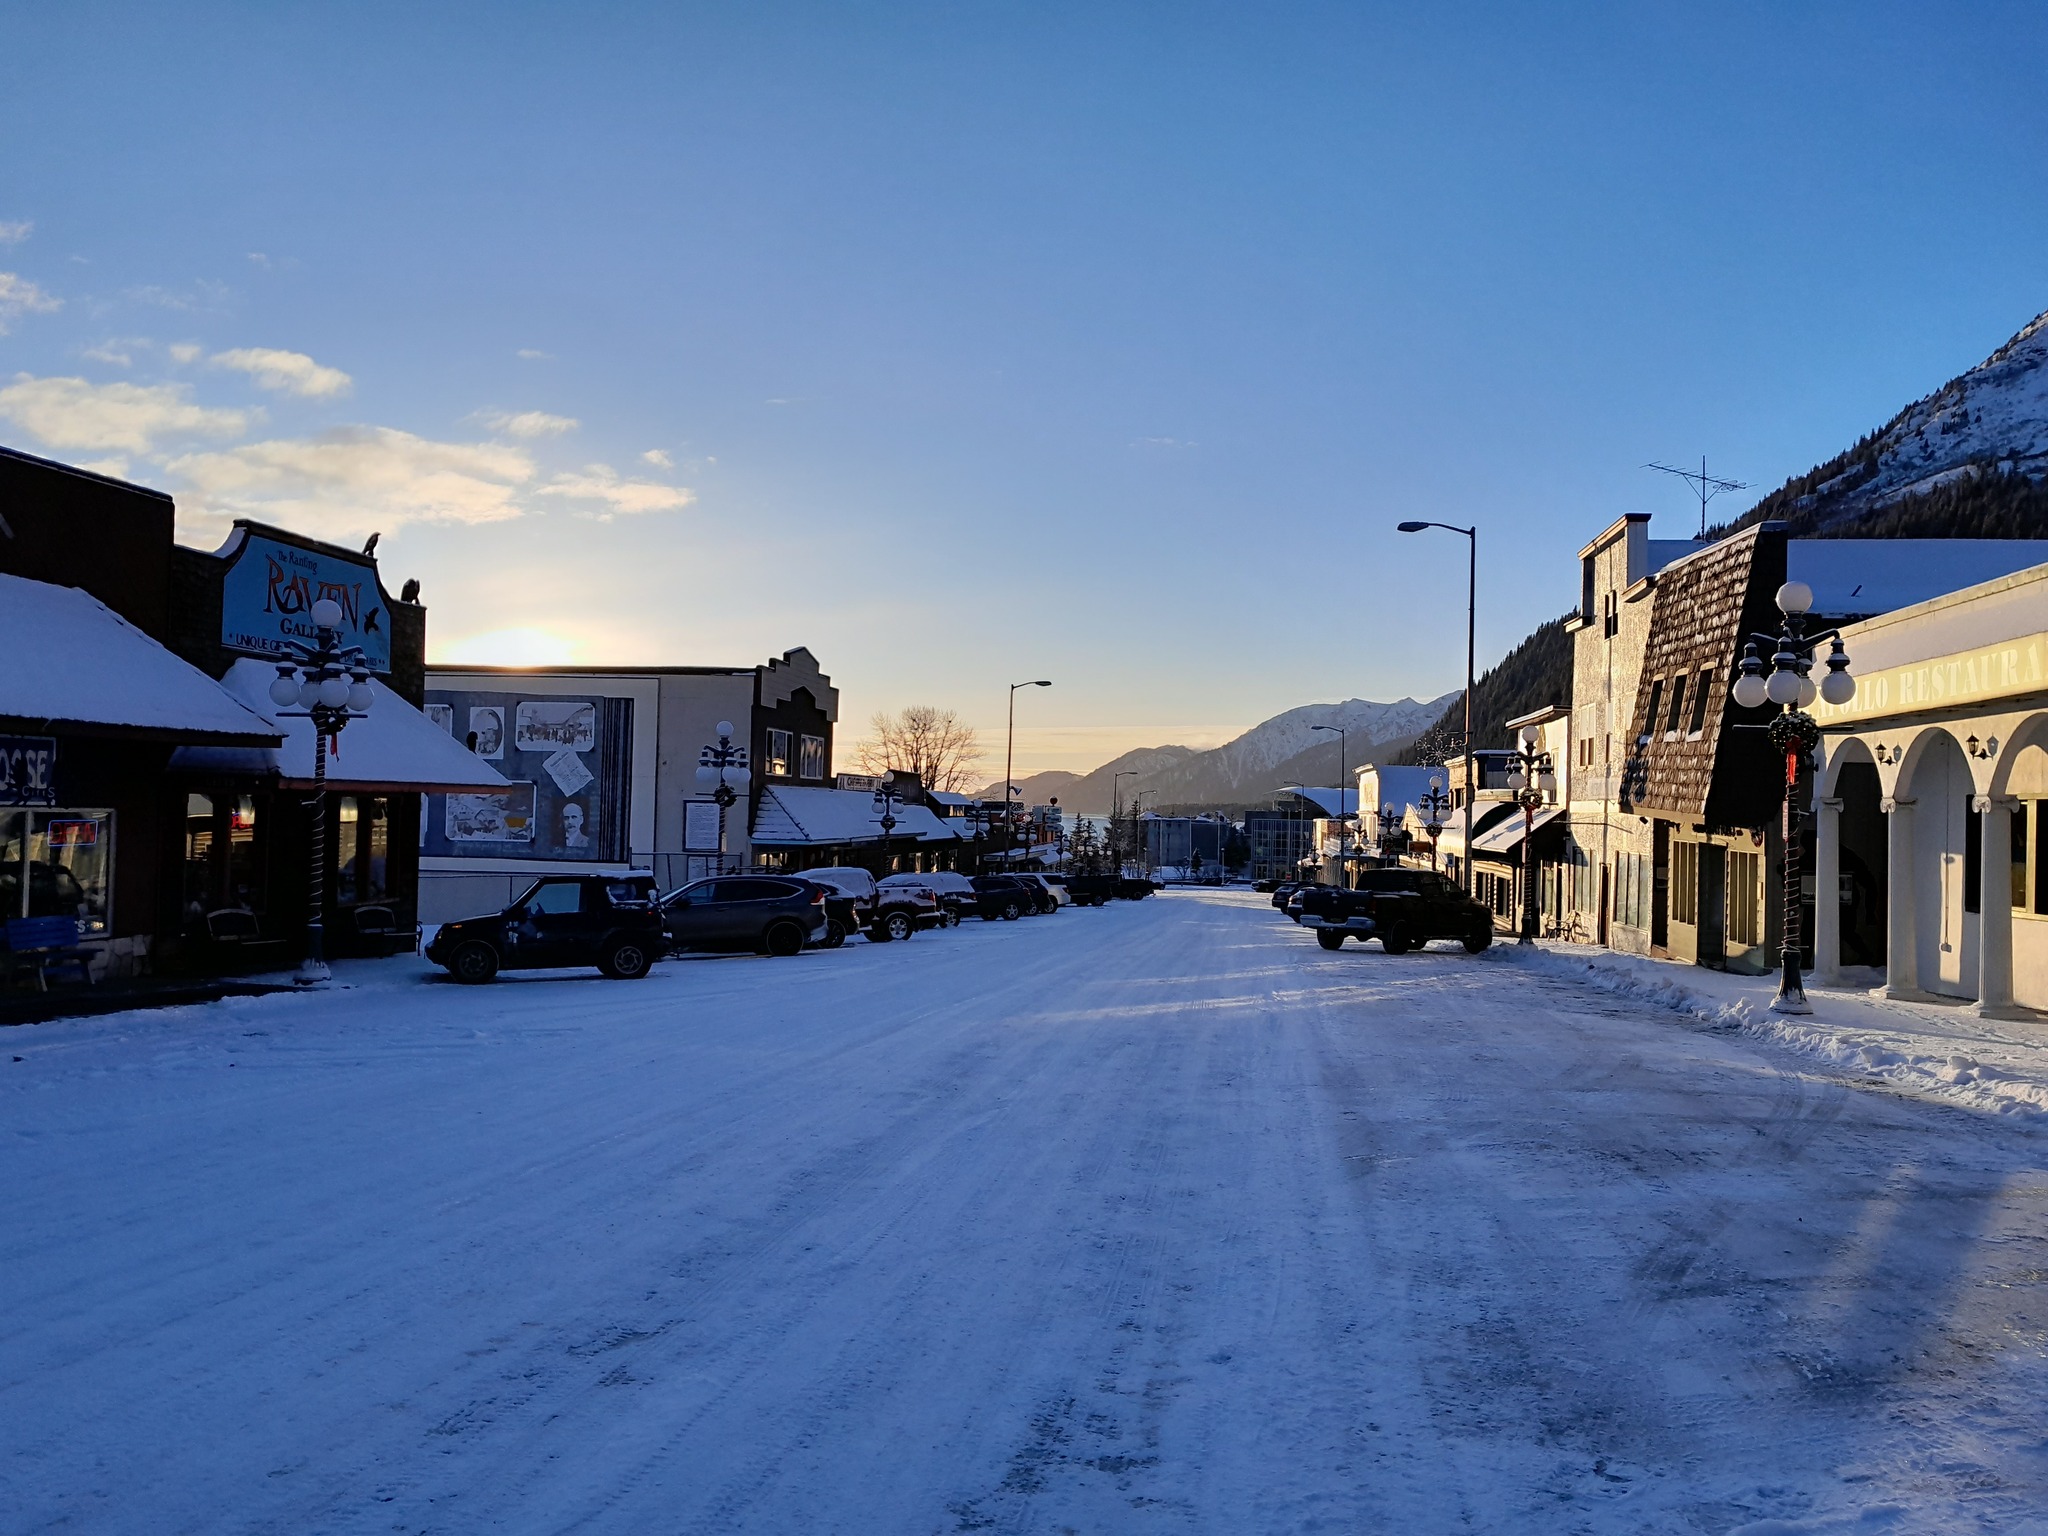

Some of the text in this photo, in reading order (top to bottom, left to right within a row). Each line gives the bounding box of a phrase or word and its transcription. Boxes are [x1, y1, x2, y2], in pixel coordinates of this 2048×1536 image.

[277, 550, 318, 575] The Ranting
[236, 633, 268, 650] UNIQUE
[280, 618, 344, 644] GALLY
[1816, 643, 2048, 718] ALLO RESTAURA
